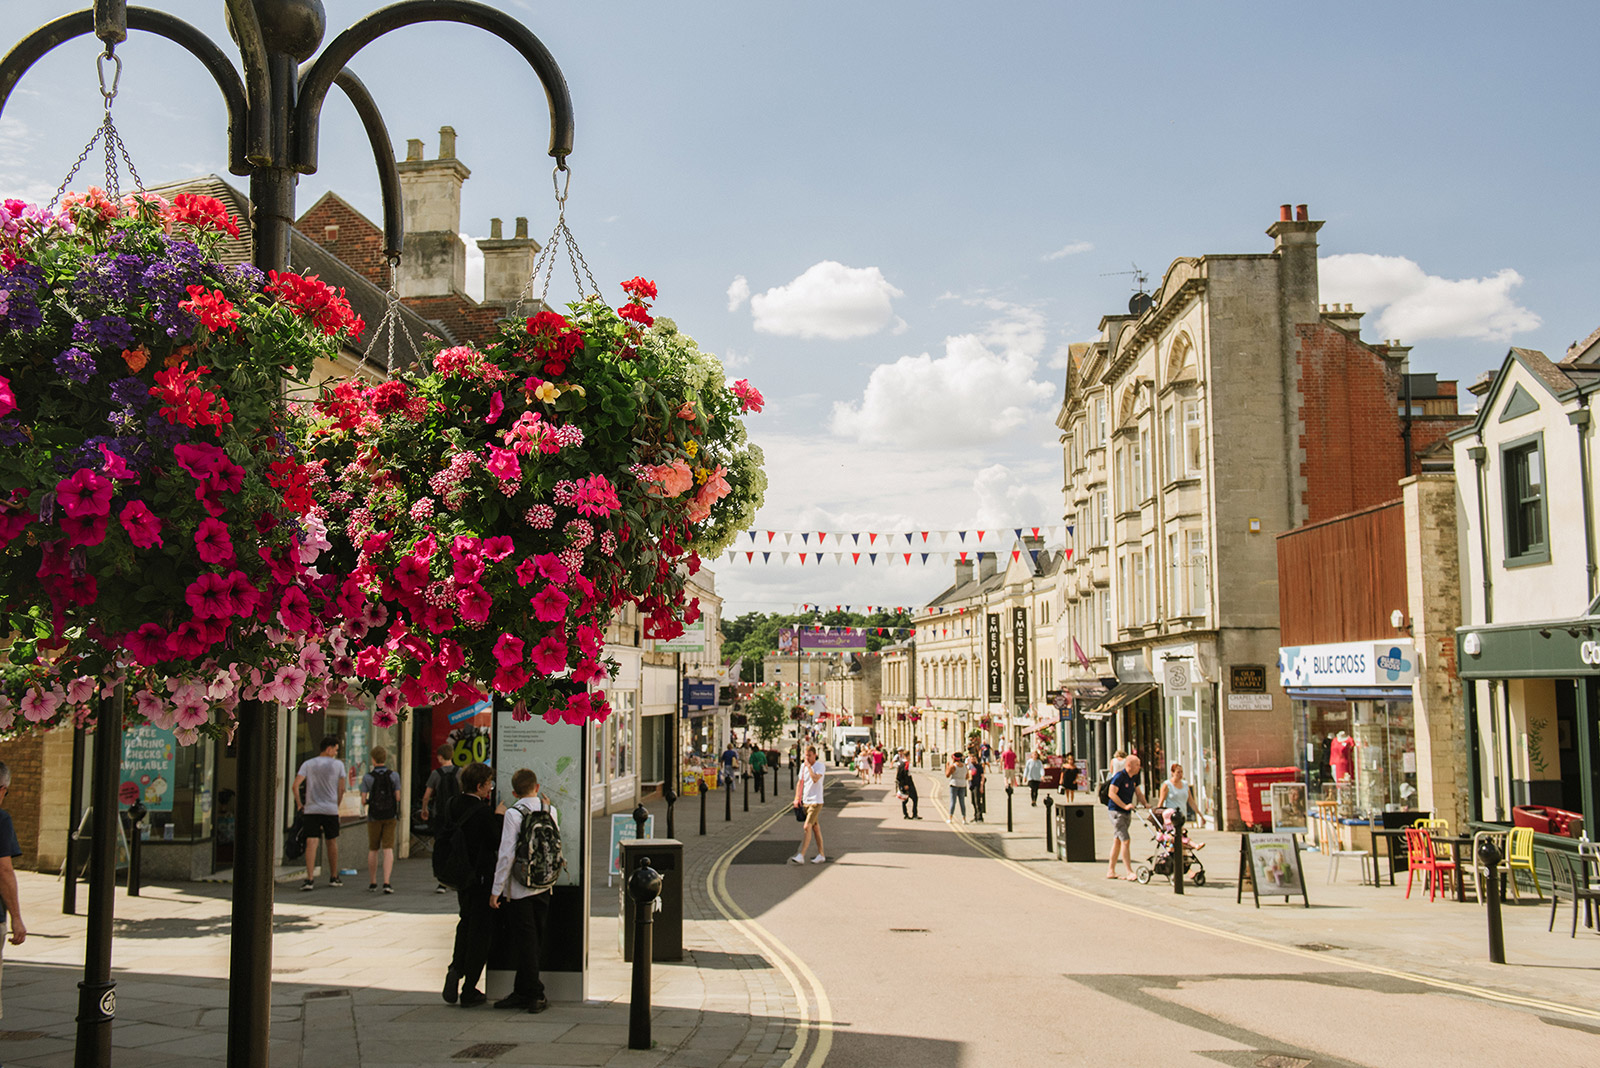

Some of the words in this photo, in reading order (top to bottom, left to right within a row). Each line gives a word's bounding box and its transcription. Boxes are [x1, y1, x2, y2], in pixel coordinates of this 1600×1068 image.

[989, 617, 998, 657] EMERY
[1016, 611, 1025, 654] EMERY
[1017, 657, 1025, 692] GATE
[1313, 656, 1333, 674] BLUE
[1334, 654, 1366, 674] CROSS
[990, 660, 998, 692] GATE
[1169, 665, 1187, 687] 3
[124, 739, 165, 748] HEARING
[133, 728, 157, 738] FREE
[126, 750, 161, 759] CHECKS
[452, 735, 487, 767] 60
[120, 761, 168, 770] AVAILABLE
